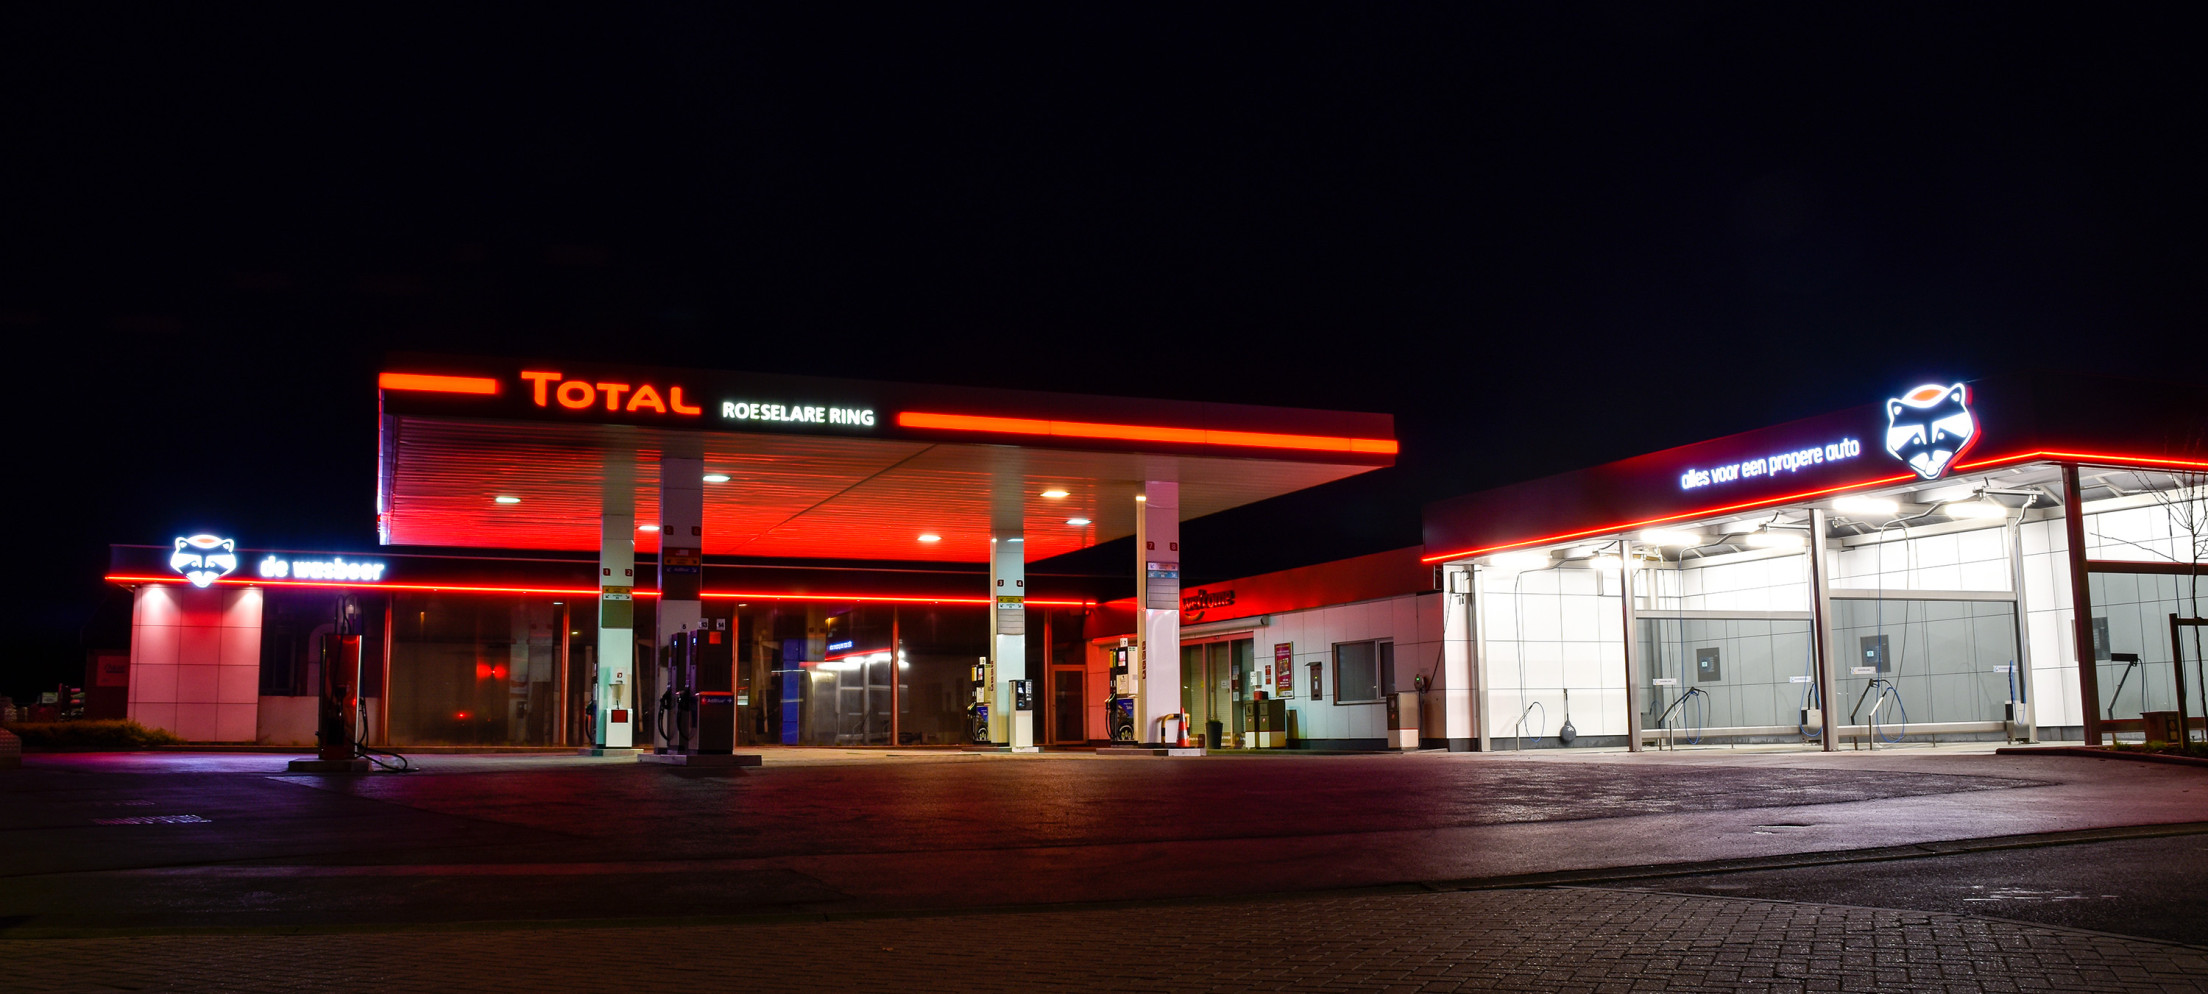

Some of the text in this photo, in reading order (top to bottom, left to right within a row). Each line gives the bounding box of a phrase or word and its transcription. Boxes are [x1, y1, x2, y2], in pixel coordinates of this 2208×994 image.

[521, 371, 702, 416] TOTAL
[722, 402, 875, 426] ROESELARE RING
[1681, 437, 1860, 490] alles voor een propere auto
[260, 555, 289, 578] de
